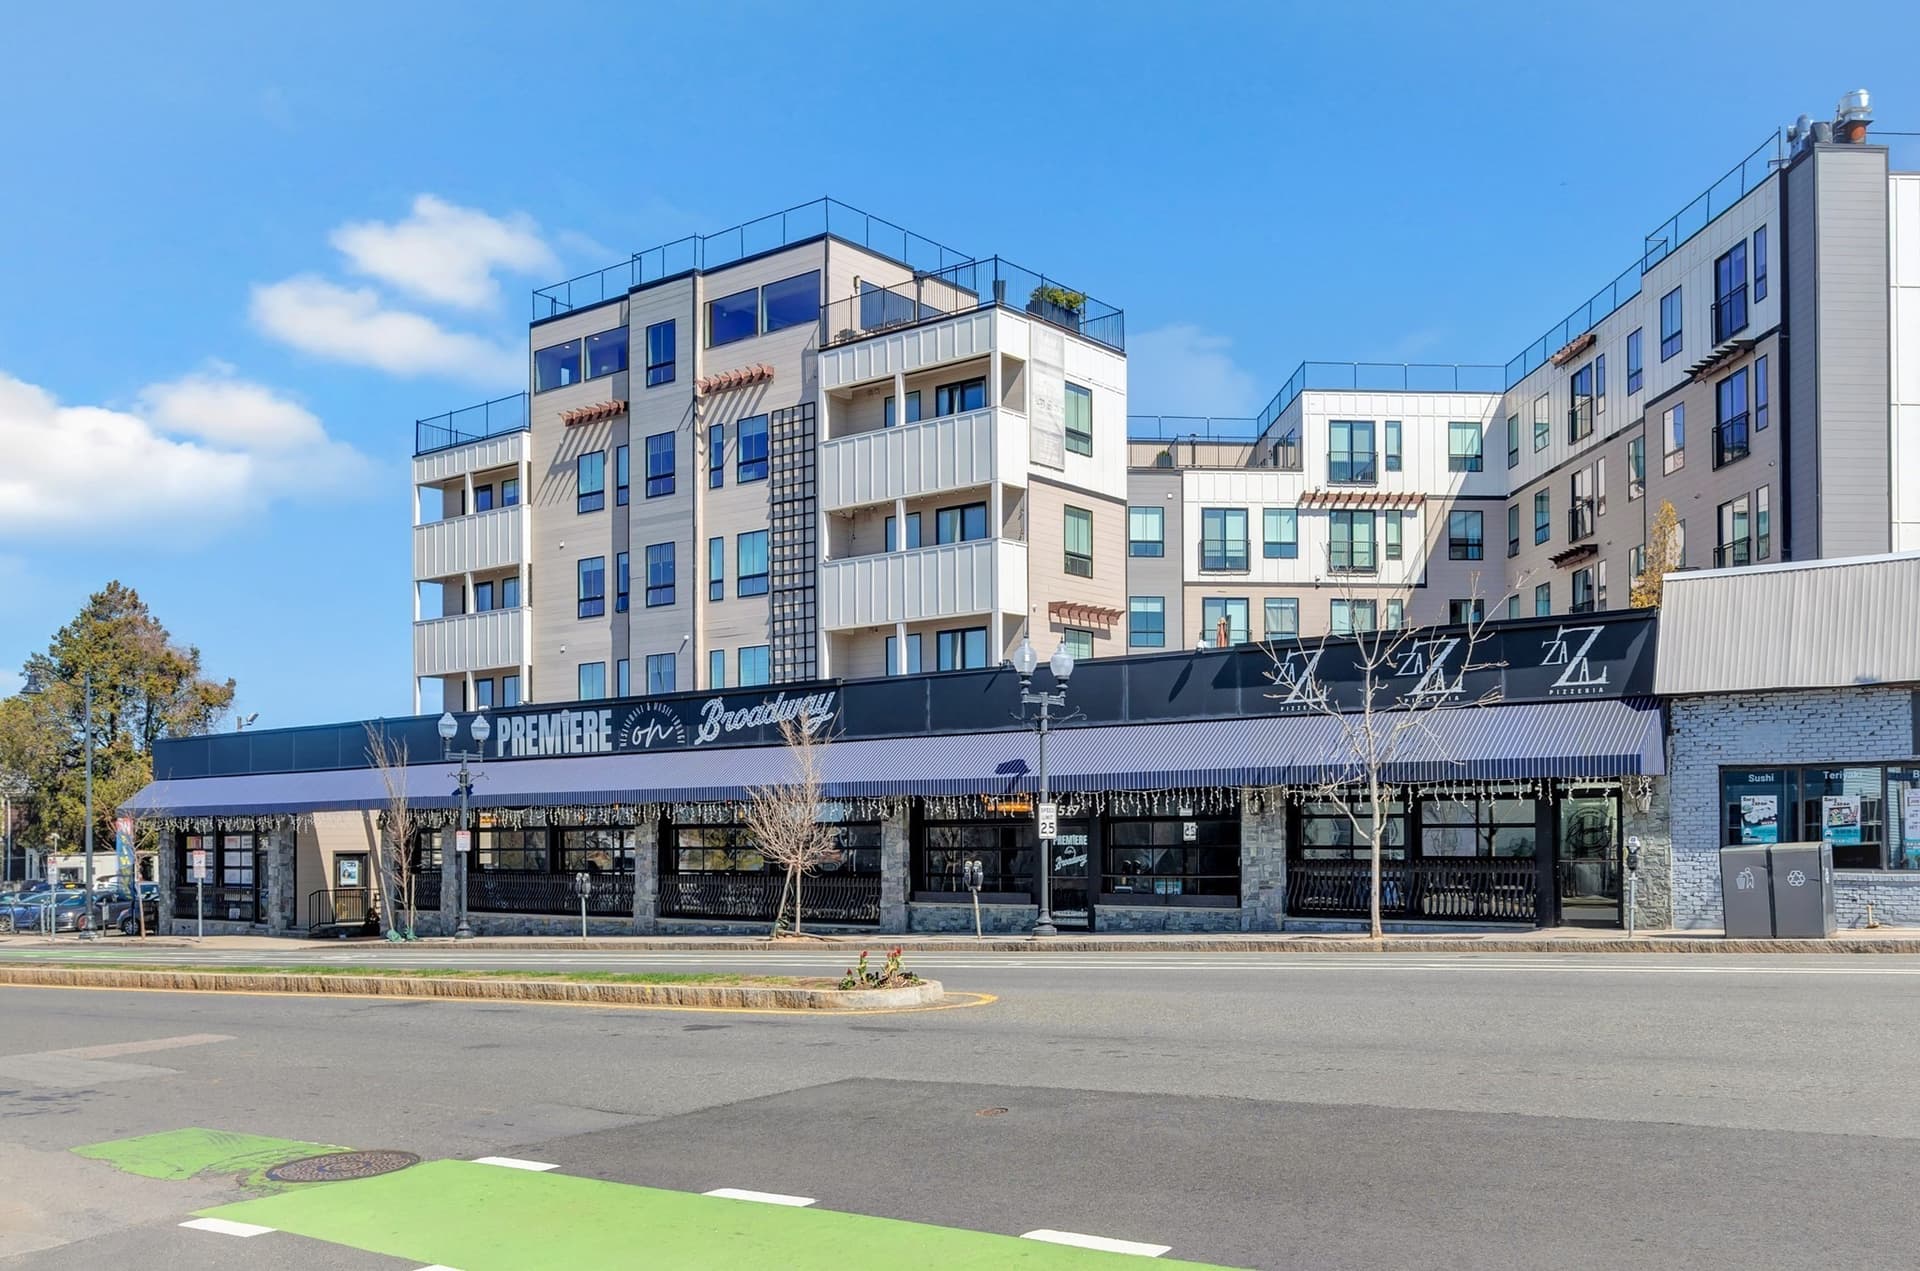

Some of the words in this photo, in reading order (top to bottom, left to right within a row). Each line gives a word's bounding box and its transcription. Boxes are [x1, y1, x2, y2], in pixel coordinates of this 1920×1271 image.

[1549, 687, 1604, 696] PIZZERIA
[497, 709, 613, 757] PREMIERE
[694, 692, 836, 745] Broadway
[1748, 773, 1775, 783] Sushi
[1058, 804, 1080, 816] 517
[1041, 822, 1055, 834] 25
